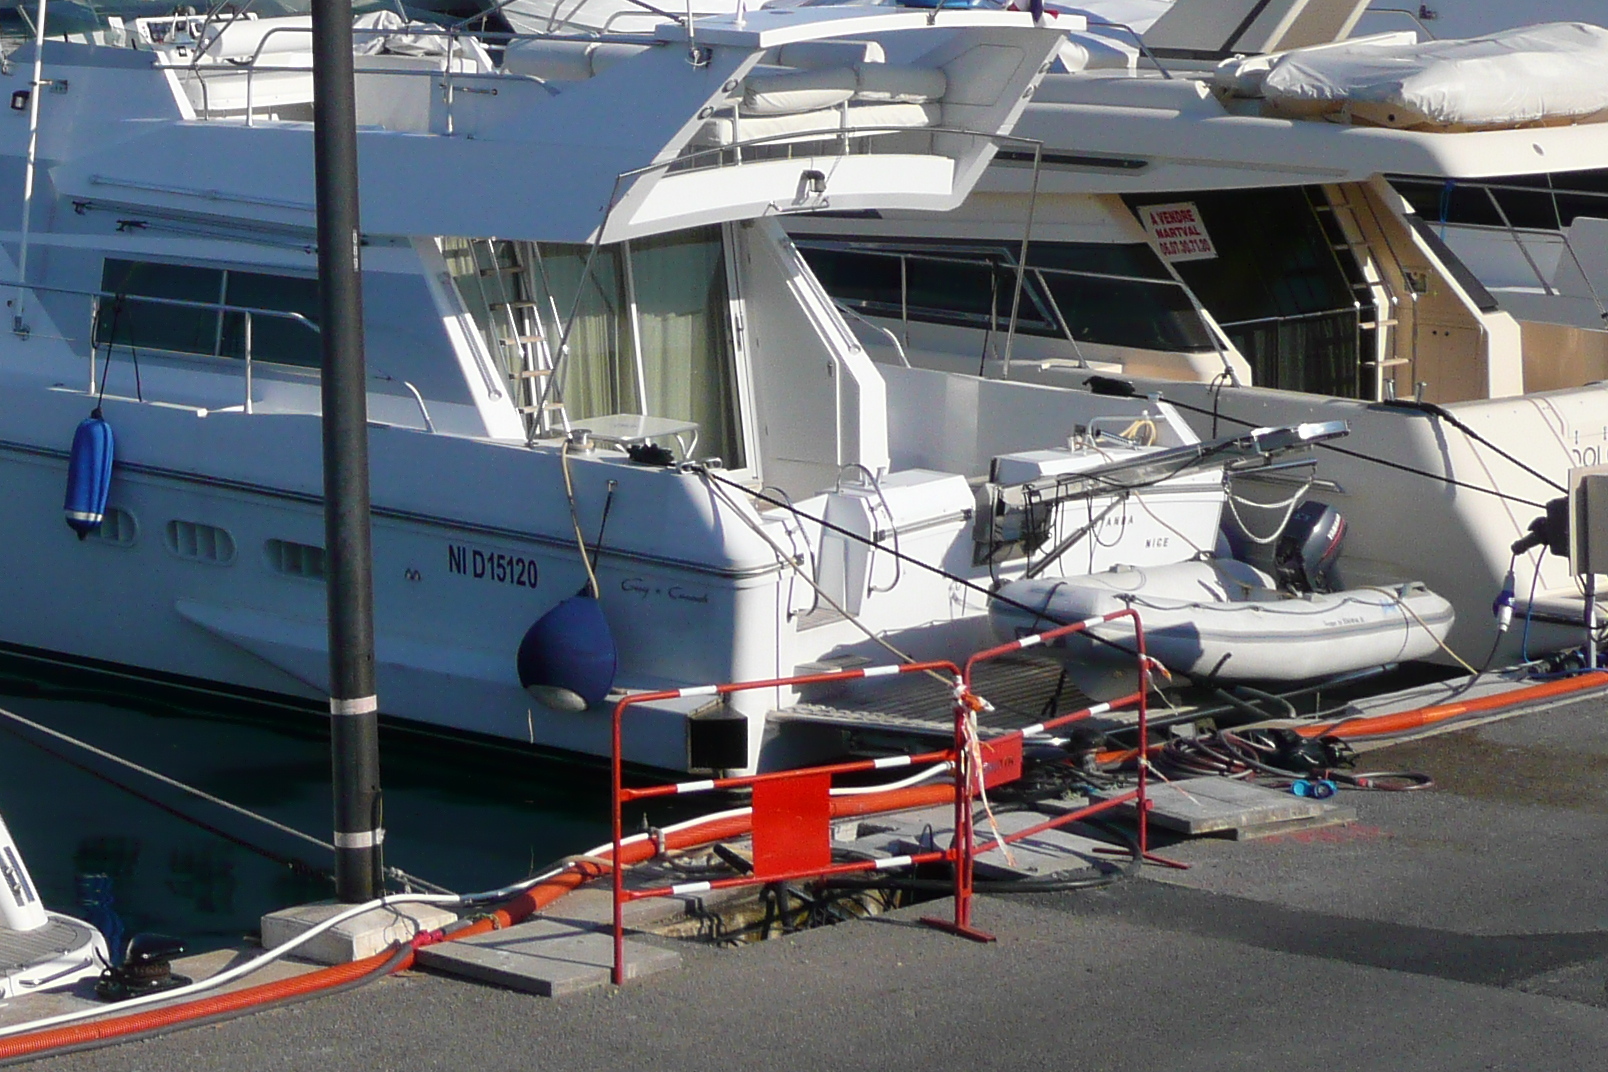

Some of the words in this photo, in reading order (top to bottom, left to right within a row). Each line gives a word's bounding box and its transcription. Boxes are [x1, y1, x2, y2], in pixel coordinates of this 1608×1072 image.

[1156, 209, 1196, 225] VENDRE
[1145, 538, 1169, 548] NICE
[448, 544, 467, 575] NI
[472, 550, 539, 589] D15120
